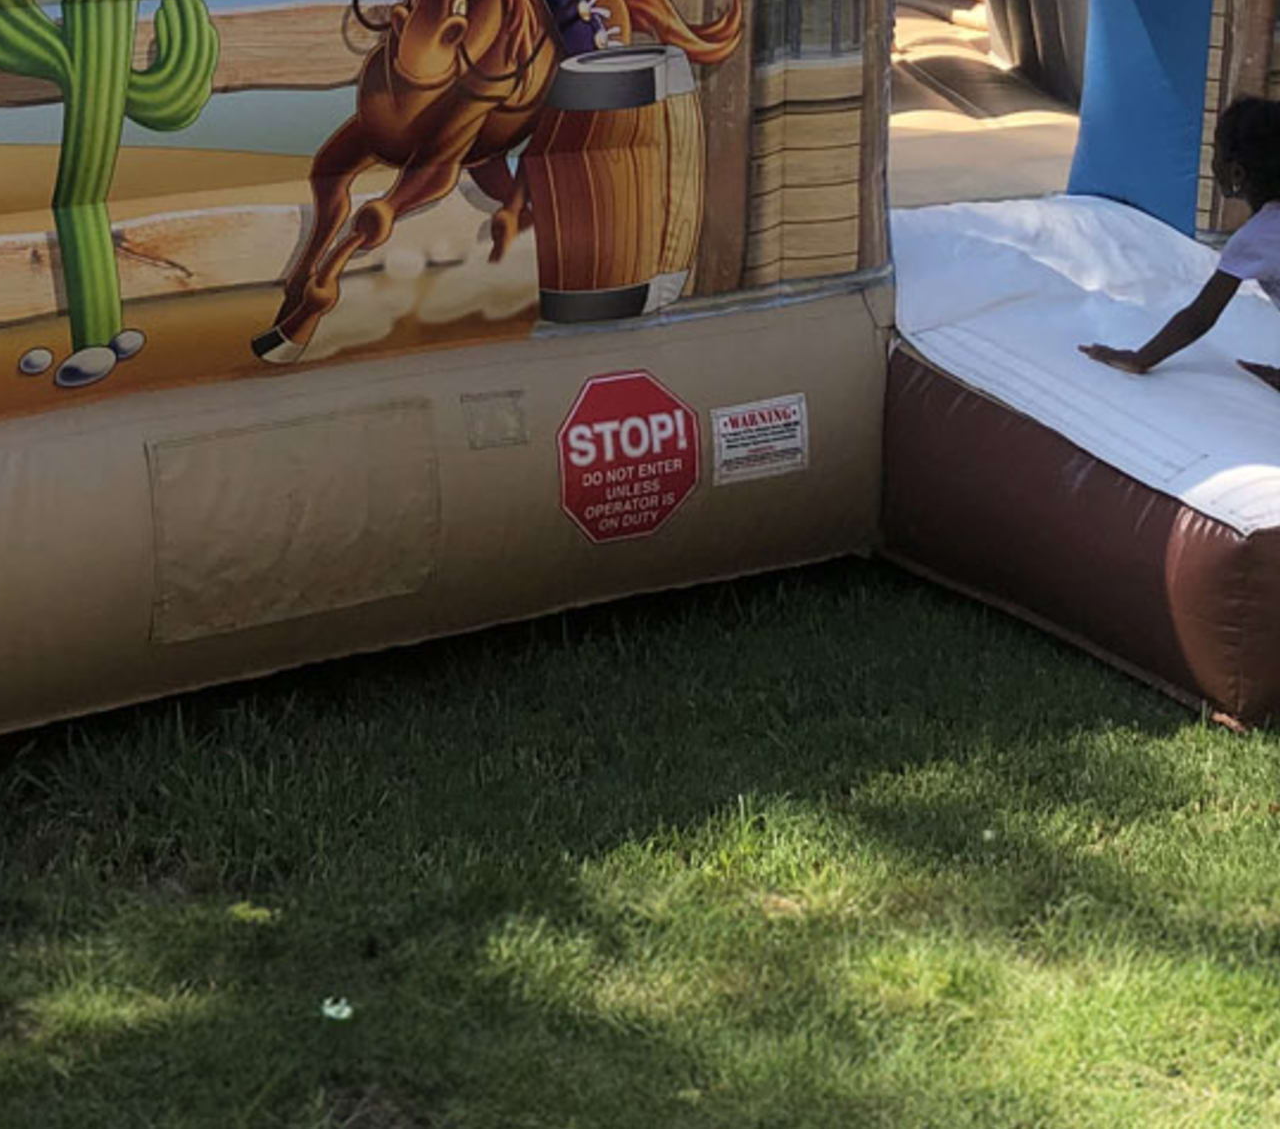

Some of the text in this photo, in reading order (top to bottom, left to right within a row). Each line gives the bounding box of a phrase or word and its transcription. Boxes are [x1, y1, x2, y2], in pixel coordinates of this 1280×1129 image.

[728, 406, 792, 429] WARNING
[568, 409, 687, 467] STOP!
[582, 458, 683, 487] DO NOT ENTER
[605, 478, 661, 501] UNLESS
[583, 492, 676, 520] OPERATOR IS
[598, 510, 658, 531] ON DUTY
